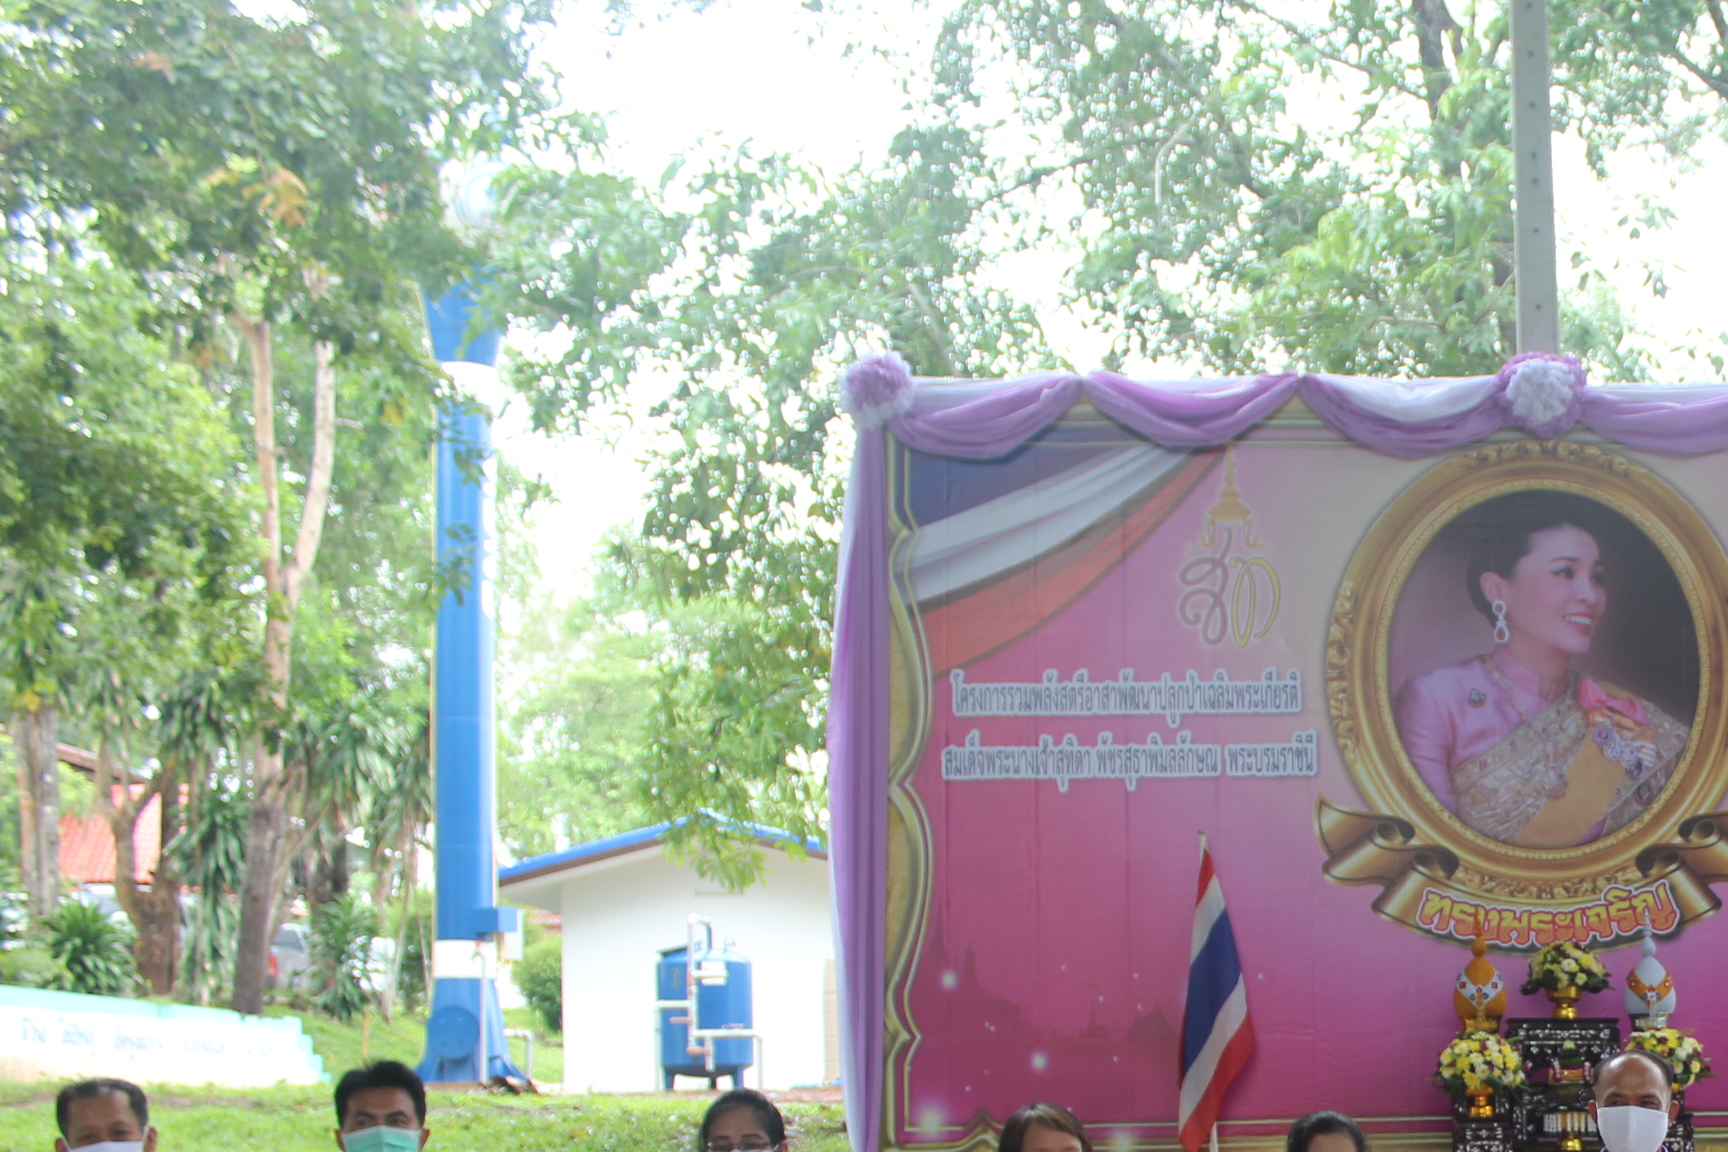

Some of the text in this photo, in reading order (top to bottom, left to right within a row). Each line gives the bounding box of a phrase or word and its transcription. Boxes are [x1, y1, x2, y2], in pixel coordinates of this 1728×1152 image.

[951, 669, 1301, 726] โครงการรวมพลังสตรีอาสาพัฒนาปลูกป่าเฉลิมพระเกียรติ
[943, 730, 1316, 792] สมเด็จพระนางเจ้าสุทิดา พัชรสุธาพิมลลักษณ พระบรมราชินี
[1417, 880, 1679, 947] ทรงพระเจริญ
